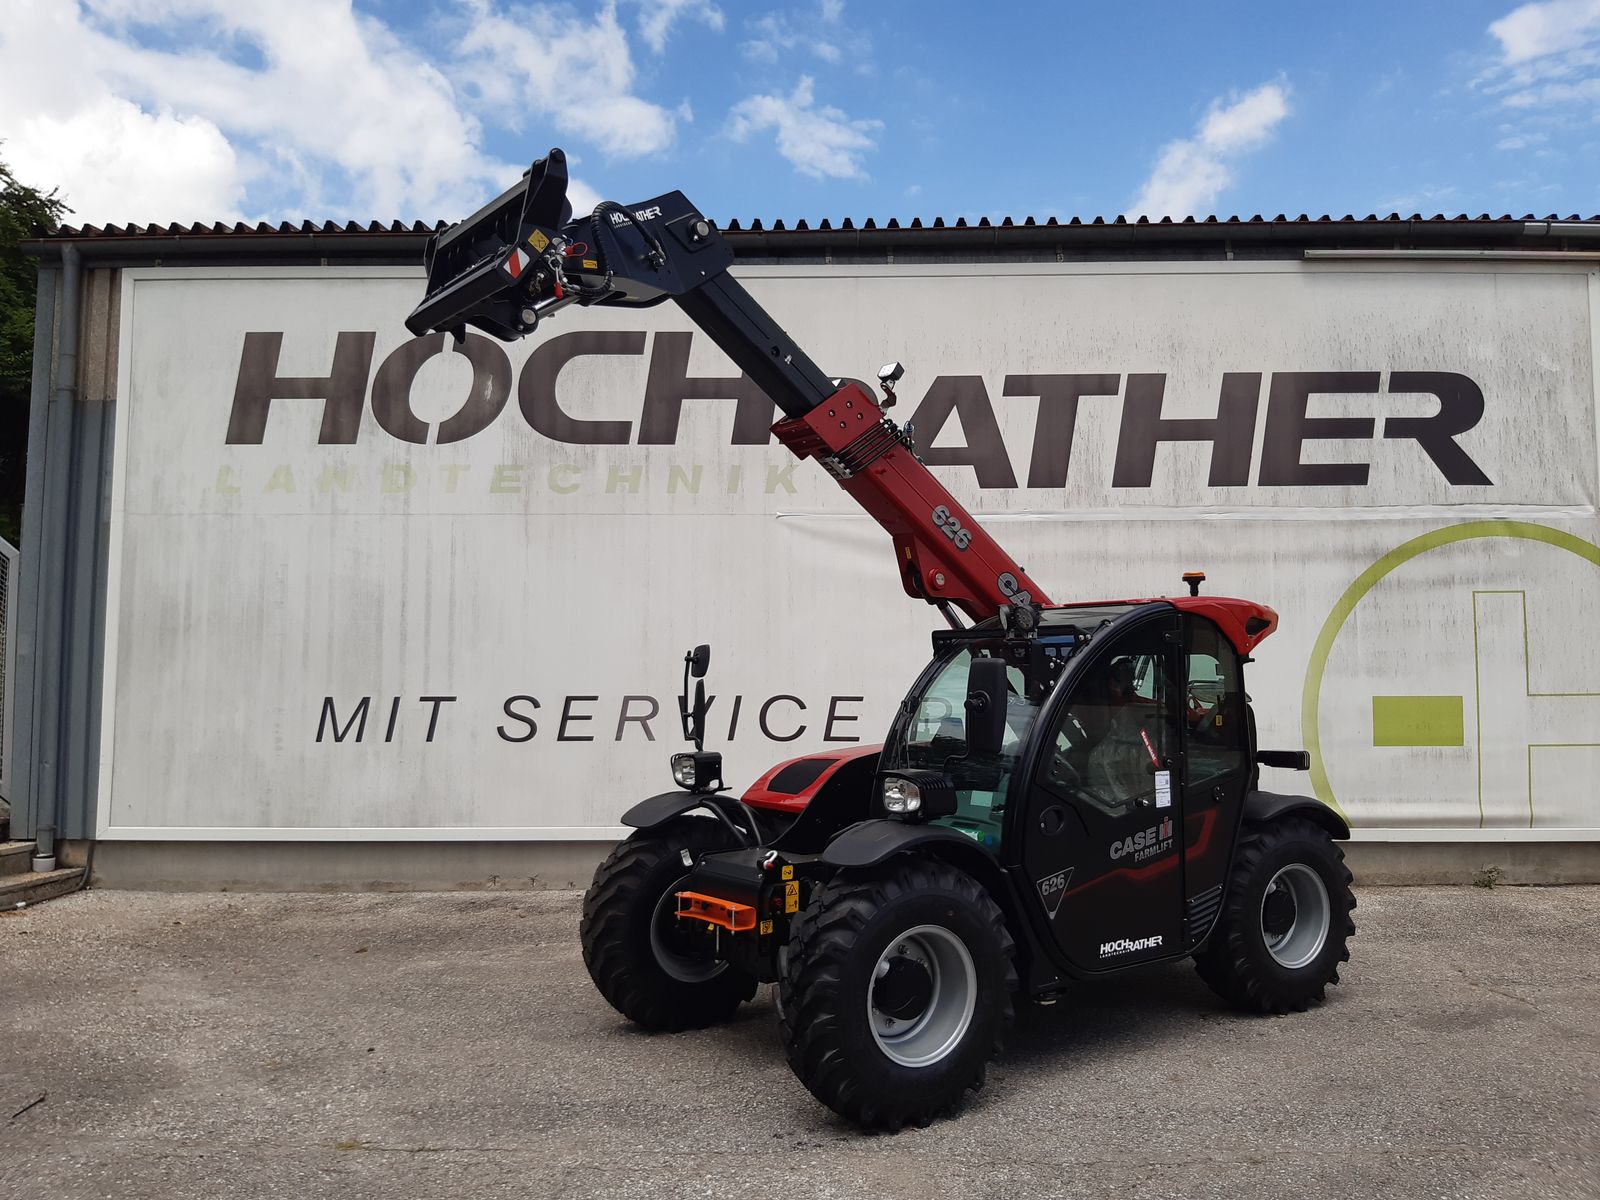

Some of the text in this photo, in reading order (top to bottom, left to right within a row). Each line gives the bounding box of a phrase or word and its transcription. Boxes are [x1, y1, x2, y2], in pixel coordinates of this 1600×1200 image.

[225, 331, 1495, 488] HOCHATHER
[214, 462, 800, 495] LANDTECHNIK
[931, 505, 972, 551] 626
[997, 572, 1033, 608] CA
[315, 696, 457, 743] MIT
[496, 694, 865, 743] SERVICE
[1109, 826, 1157, 860] CASE
[1134, 838, 1174, 863] FARMLIFT
[1041, 874, 1065, 896] 626
[1099, 935, 1163, 955] HOCHRATHER
